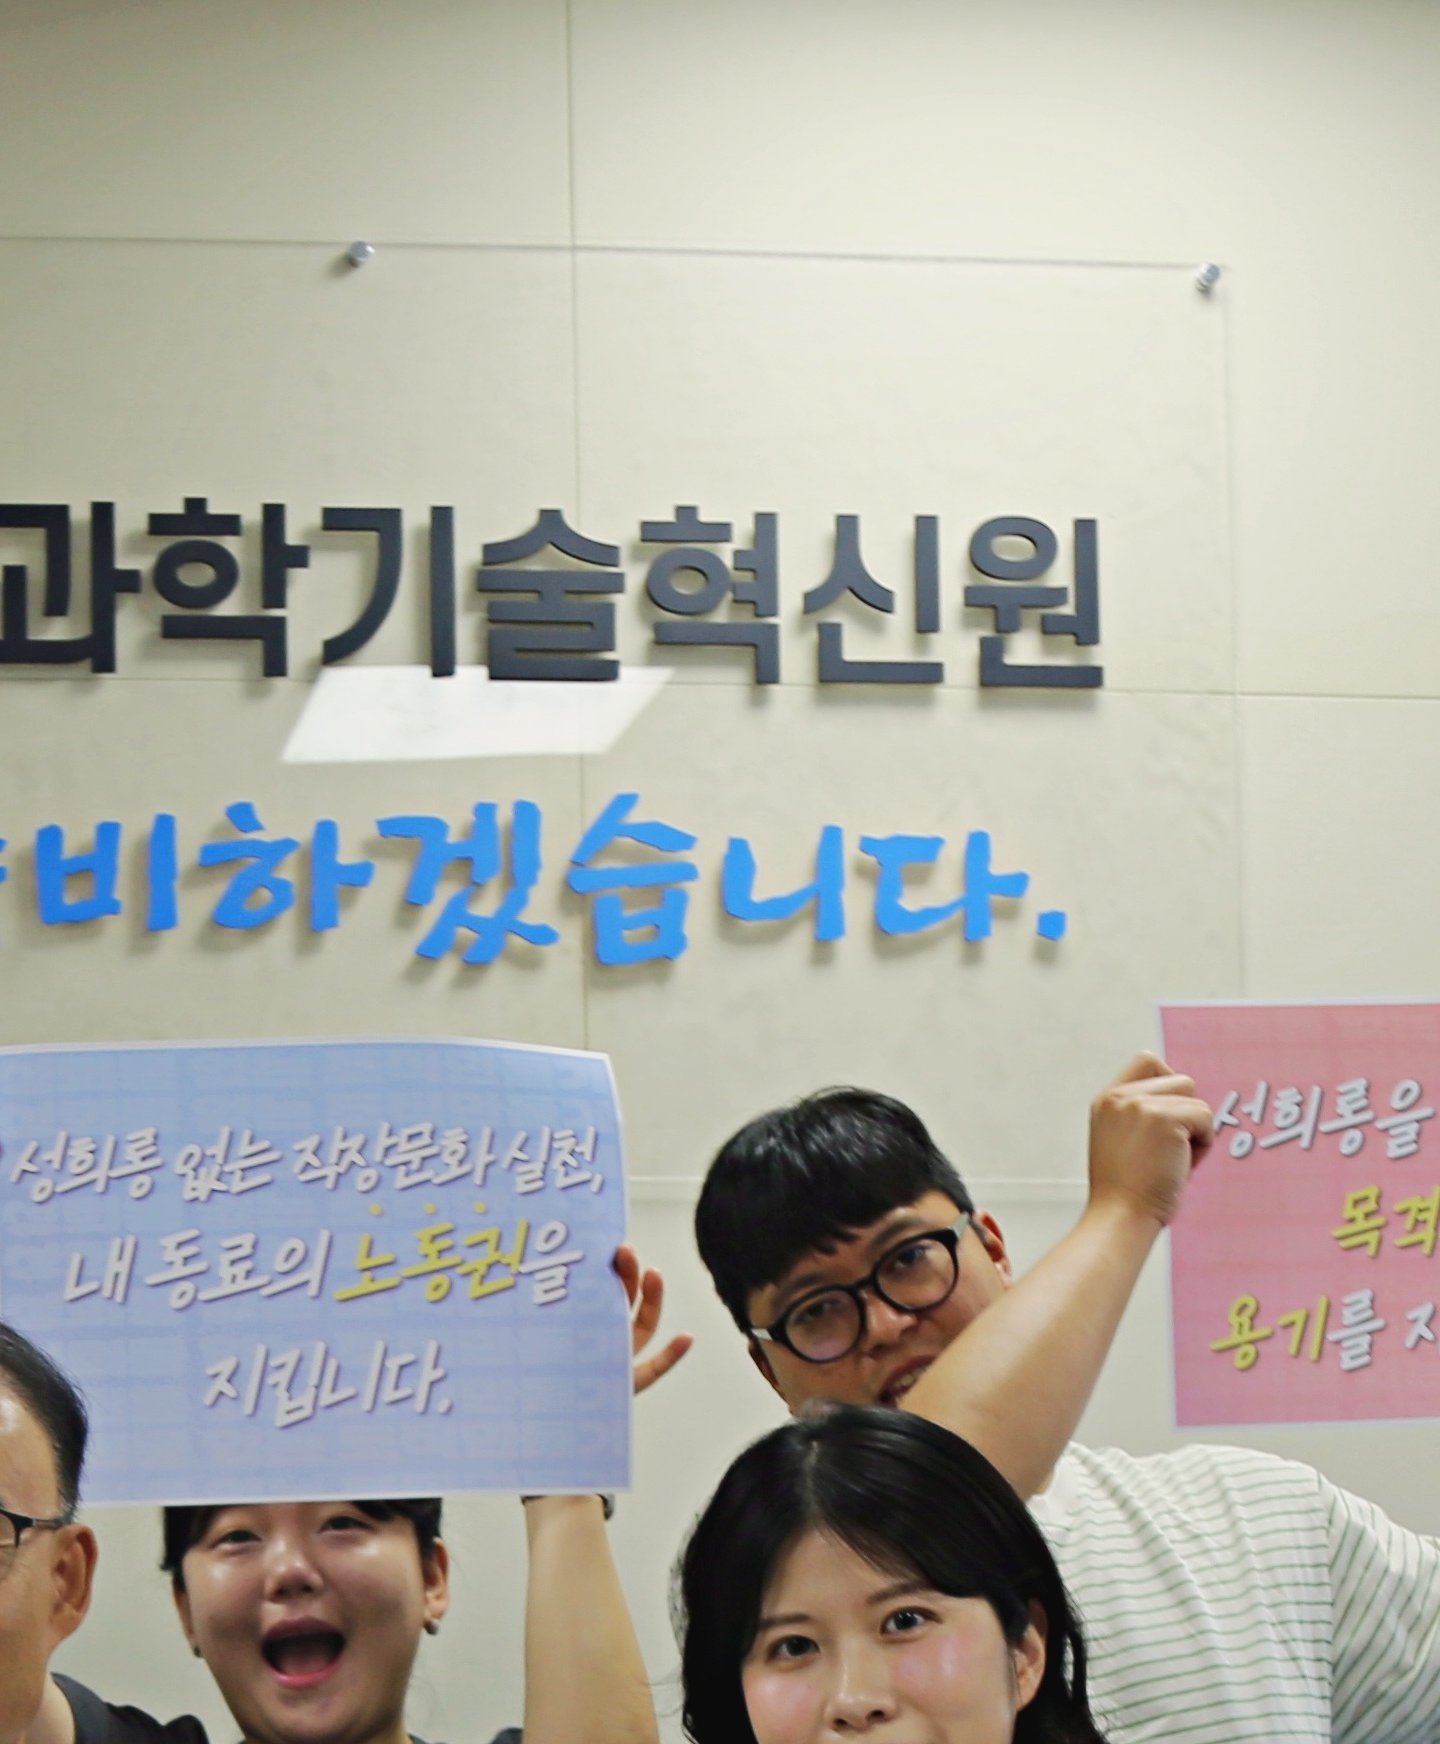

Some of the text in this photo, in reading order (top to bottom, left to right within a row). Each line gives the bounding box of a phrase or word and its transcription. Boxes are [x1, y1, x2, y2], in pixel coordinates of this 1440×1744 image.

[1213, 1077, 1434, 1159] 성희롱을
[11, 1122, 604, 1202] 성희롱 없는 직장문화 실천,
[64, 1218, 583, 1309] 내 동료의 노동권을
[1211, 1288, 1384, 1371] 용기를
[204, 1341, 452, 1428] 지킵니다.
